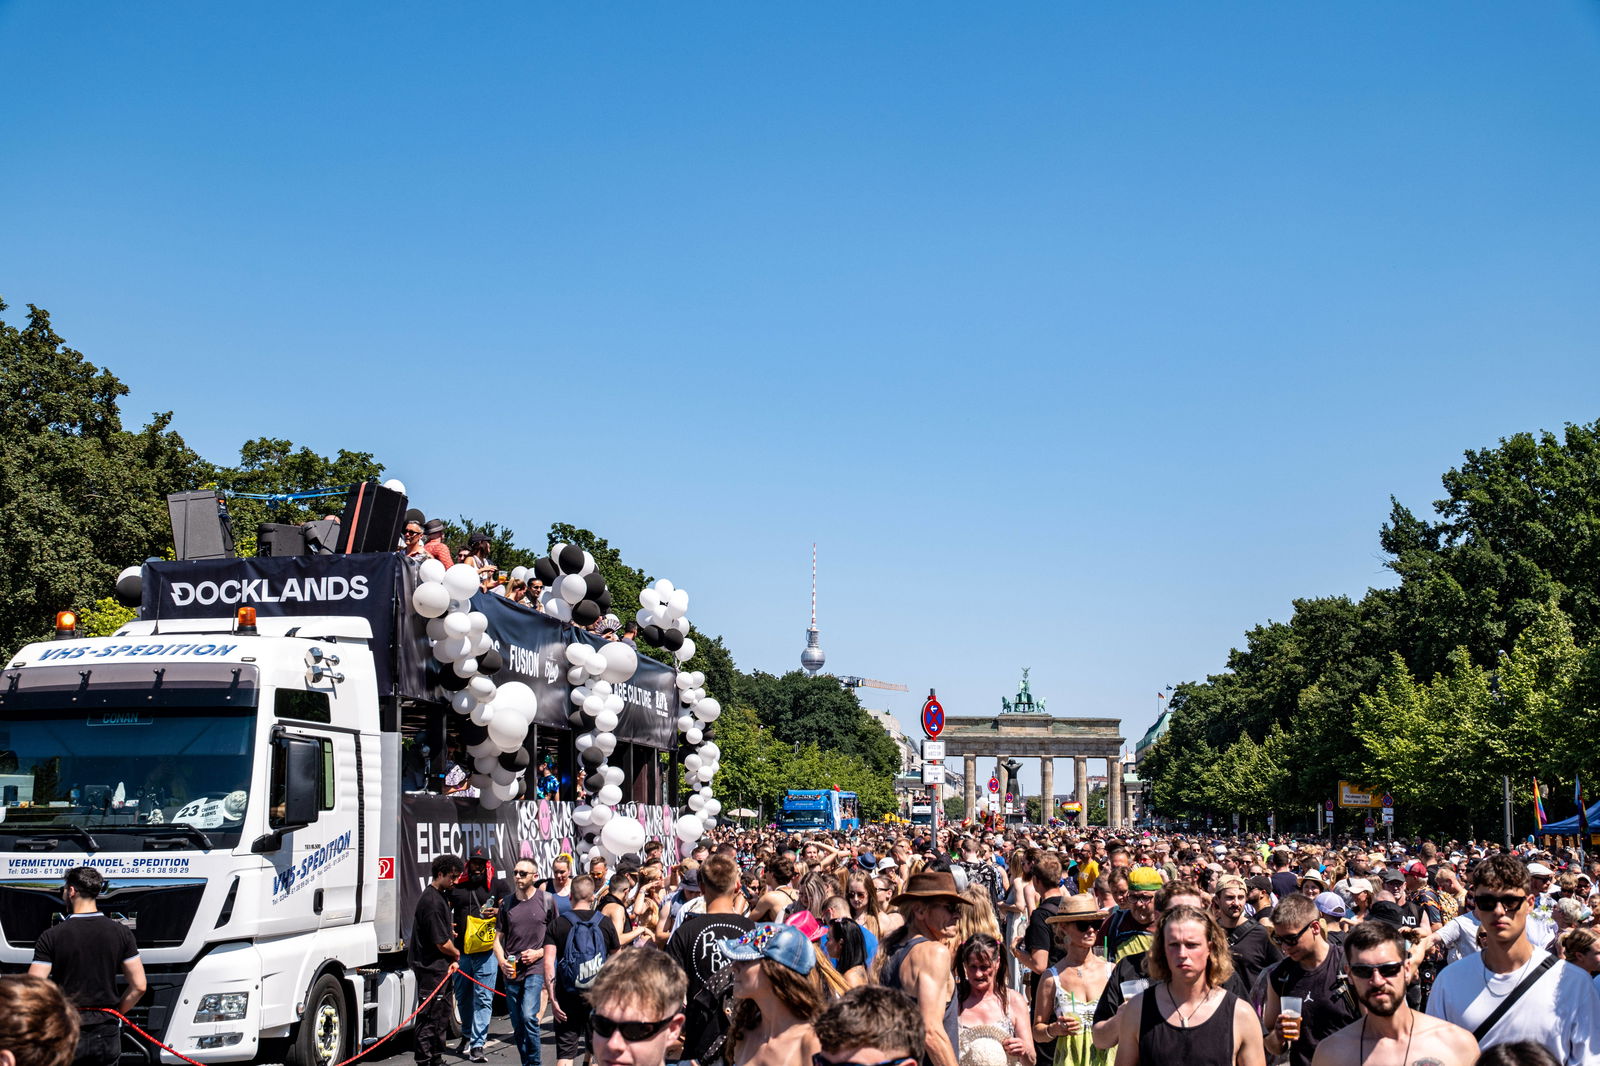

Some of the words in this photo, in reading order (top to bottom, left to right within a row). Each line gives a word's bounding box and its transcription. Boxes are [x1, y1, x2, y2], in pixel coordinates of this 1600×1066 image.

[170, 575, 369, 606] DOCKLANDS
[38, 643, 238, 661] VHS-SPEDITION
[509, 644, 540, 678] FUSION
[627, 684, 652, 709] CULTURE
[178, 804, 200, 819] 23
[416, 822, 505, 863] ELECTRIFY
[8, 859, 75, 867] VERMIETUNG
[82, 858, 124, 867] HANDEL
[132, 858, 190, 867] SPEDITION
[273, 830, 351, 896] VHS-SPEDITION
